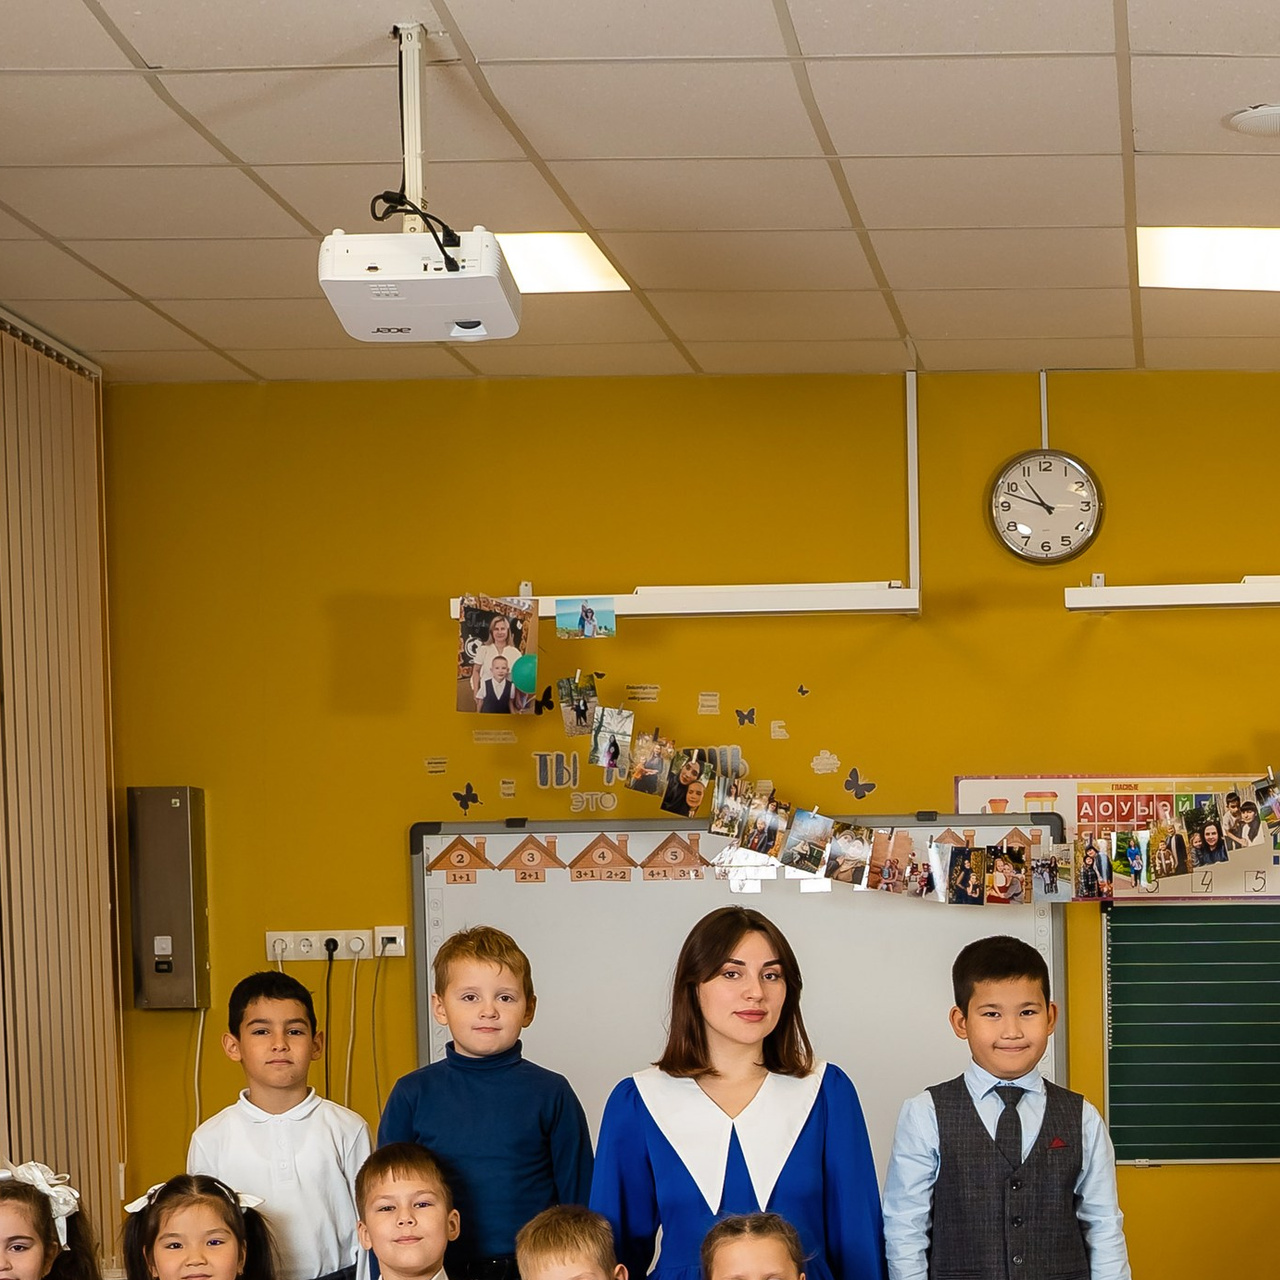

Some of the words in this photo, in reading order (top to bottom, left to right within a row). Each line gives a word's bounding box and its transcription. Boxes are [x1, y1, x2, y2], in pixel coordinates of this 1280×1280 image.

[371, 327, 412, 335] acer
[1022, 466, 1031, 477] 11
[1039, 461, 1053, 472] 12
[1064, 466, 1068, 477] 1
[1007, 482, 1018, 493] 10
[1074, 481, 1085, 492] 2
[1000, 501, 1011, 512] 9
[1080, 501, 1091, 512] 3
[1006, 521, 1018, 532] 8
[1021, 536, 1031, 547] 7
[1041, 541, 1052, 552] 6
[1060, 536, 1072, 547] 5
[533, 752, 578, 787] ТЫ
[1111, 783, 1139, 791] ГЛАСНЫЕ
[571, 793, 617, 811] ЭТО
[456, 853, 465, 864] 2
[527, 852, 536, 863] 3
[597, 851, 607, 862] 4
[669, 850, 679, 860] 5
[451, 873, 471, 882] 1+1
[520, 871, 539, 880] 2+1
[575, 870, 595, 879] 3+1
[606, 870, 627, 880] 2+2
[648, 870, 667, 878] 4+1
[1201, 871, 1213, 892] 4
[1252, 870, 1267, 892] 5
